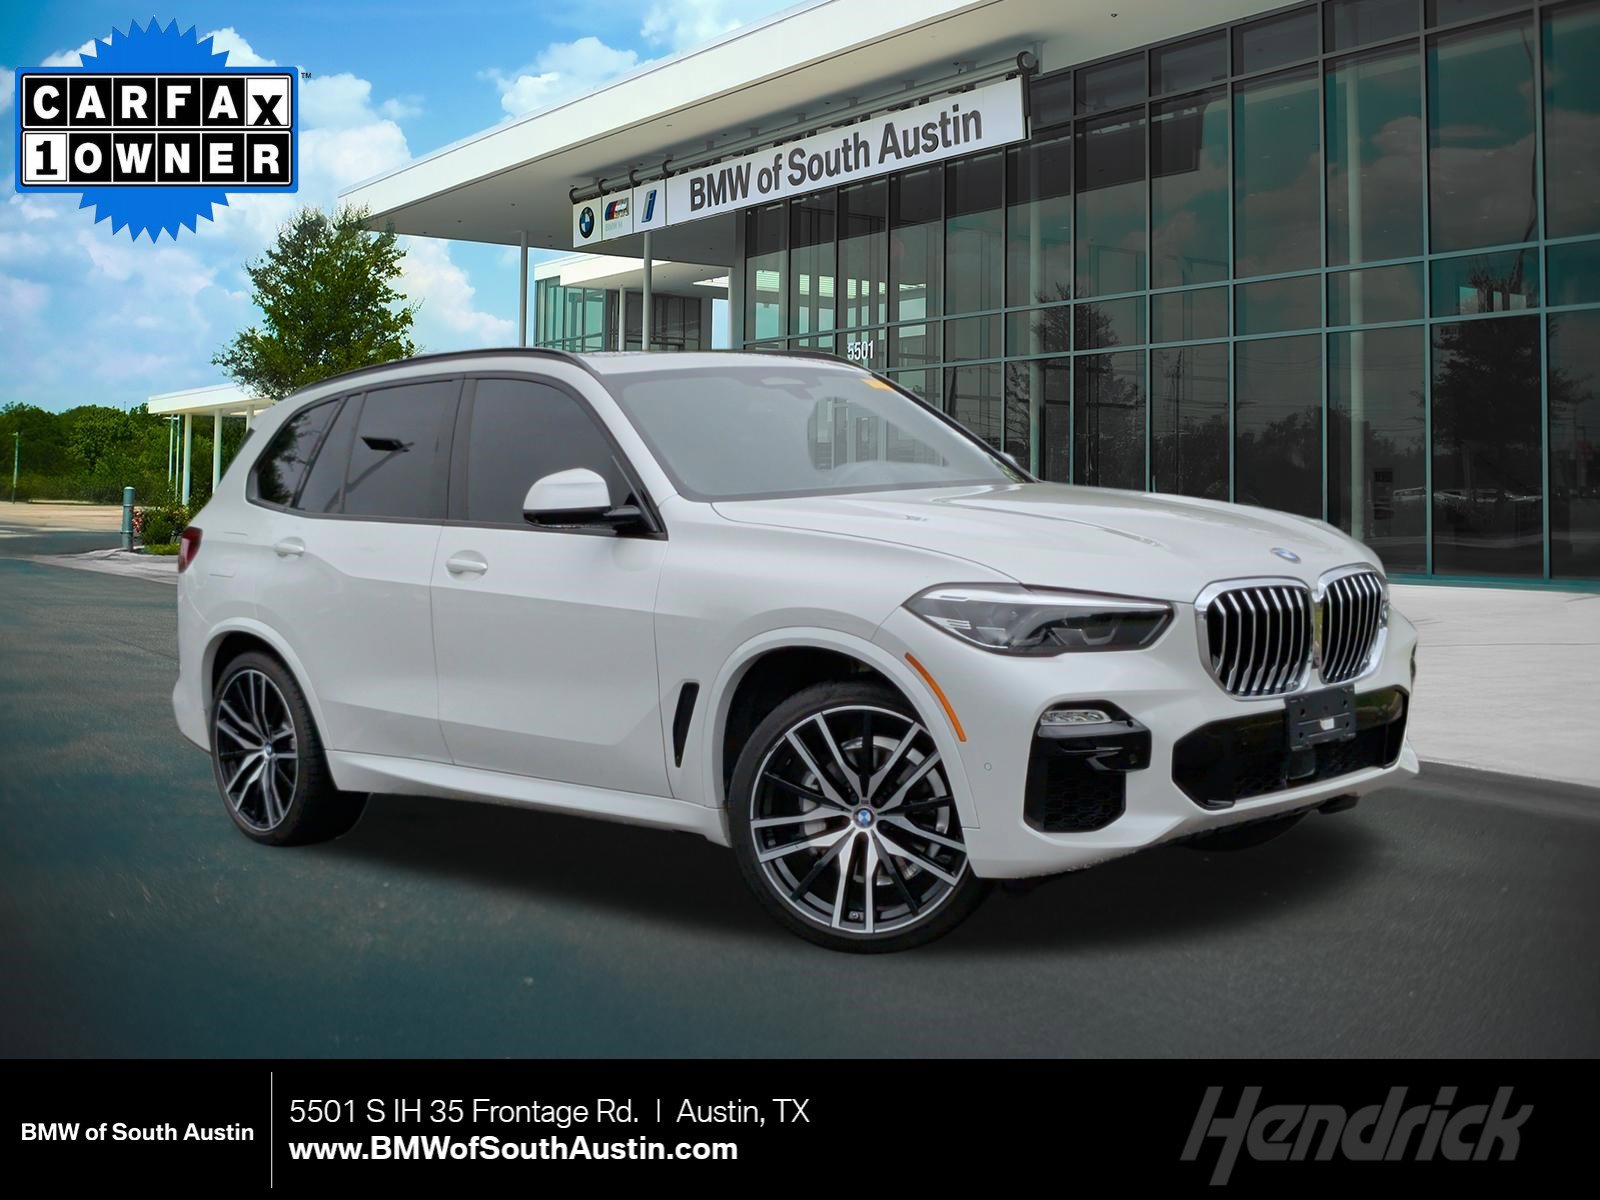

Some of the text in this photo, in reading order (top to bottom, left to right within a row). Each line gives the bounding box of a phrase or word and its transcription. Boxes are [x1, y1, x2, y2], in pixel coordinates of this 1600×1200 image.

[690, 162, 752, 211] BMW
[757, 153, 783, 194] of
[787, 132, 870, 186] South
[878, 104, 983, 164] Austin
[847, 340, 874, 361] 5501
